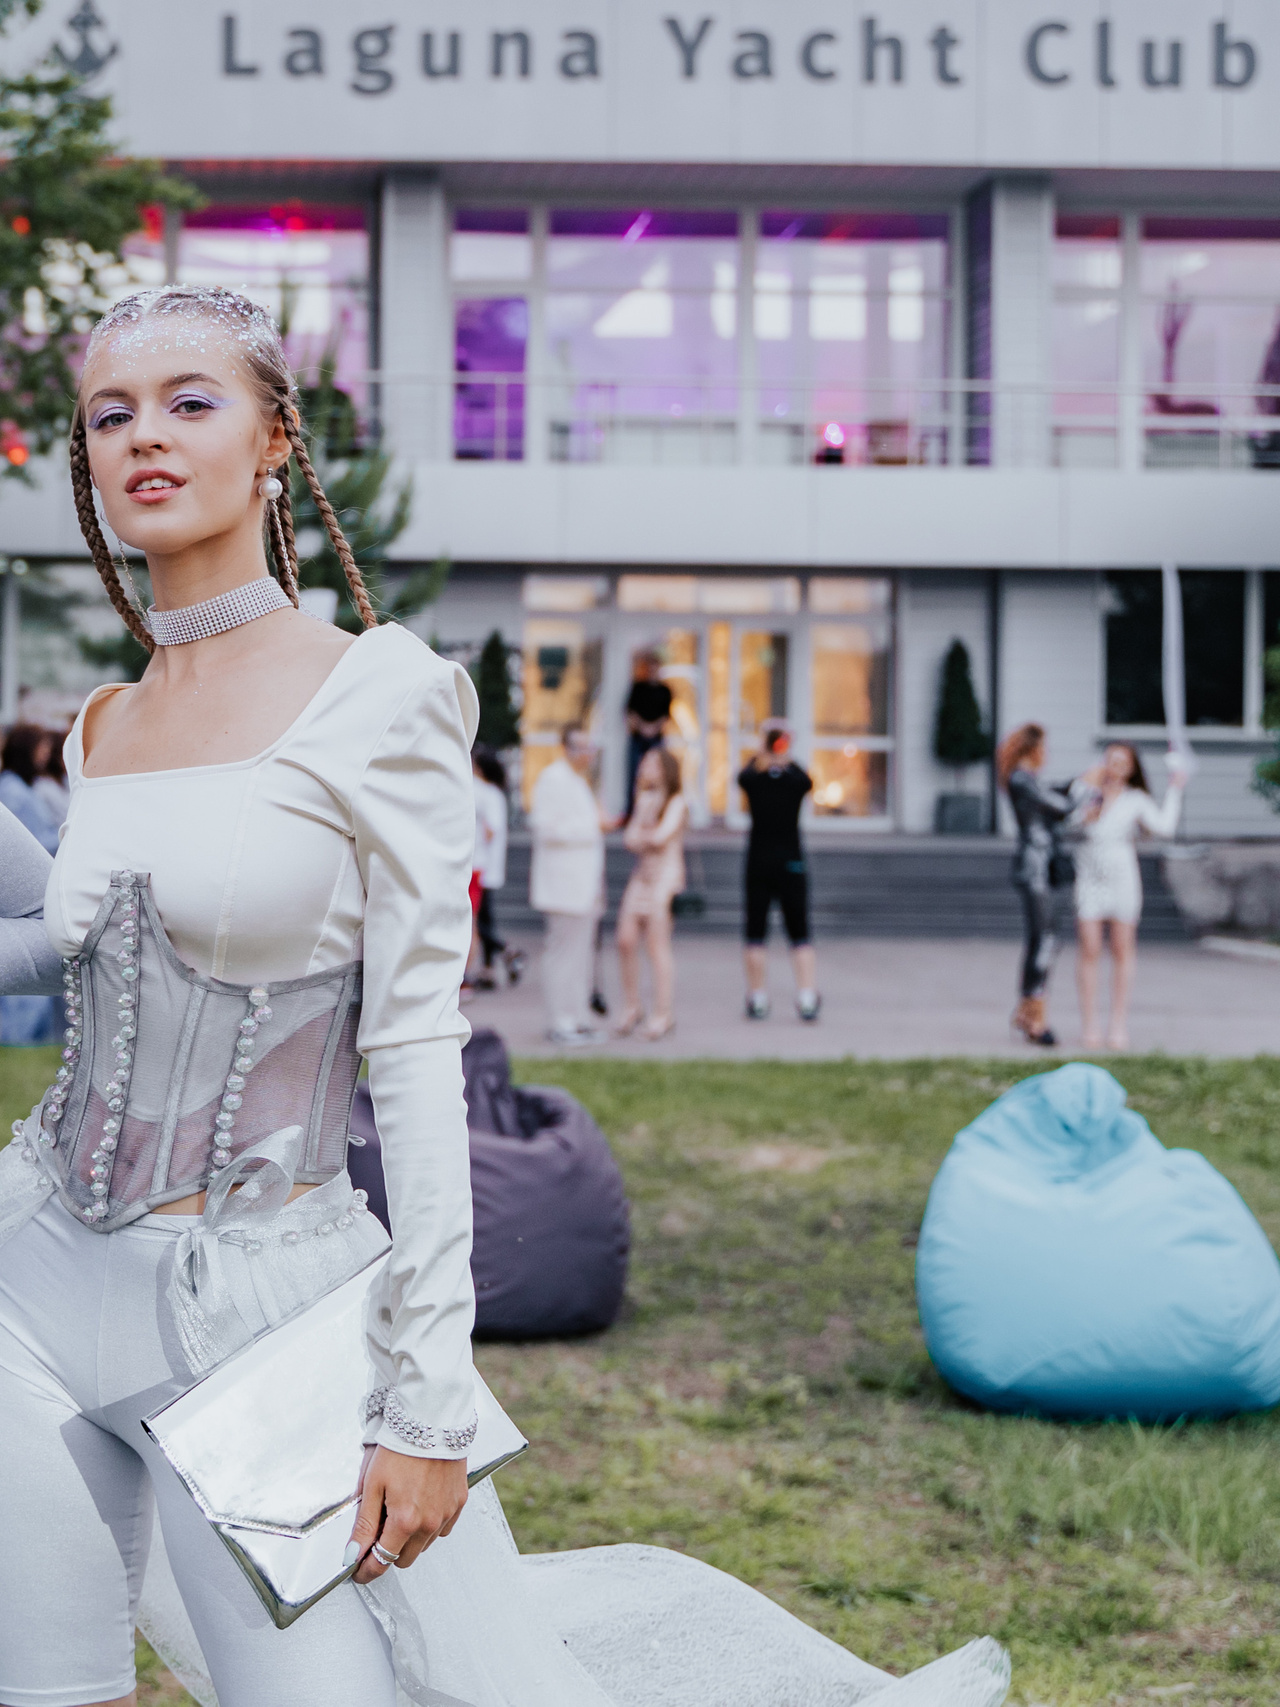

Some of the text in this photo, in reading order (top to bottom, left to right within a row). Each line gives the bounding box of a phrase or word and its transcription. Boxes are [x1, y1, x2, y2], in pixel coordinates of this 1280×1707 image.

[222, 14, 1258, 97] Laguna Yacht Club
